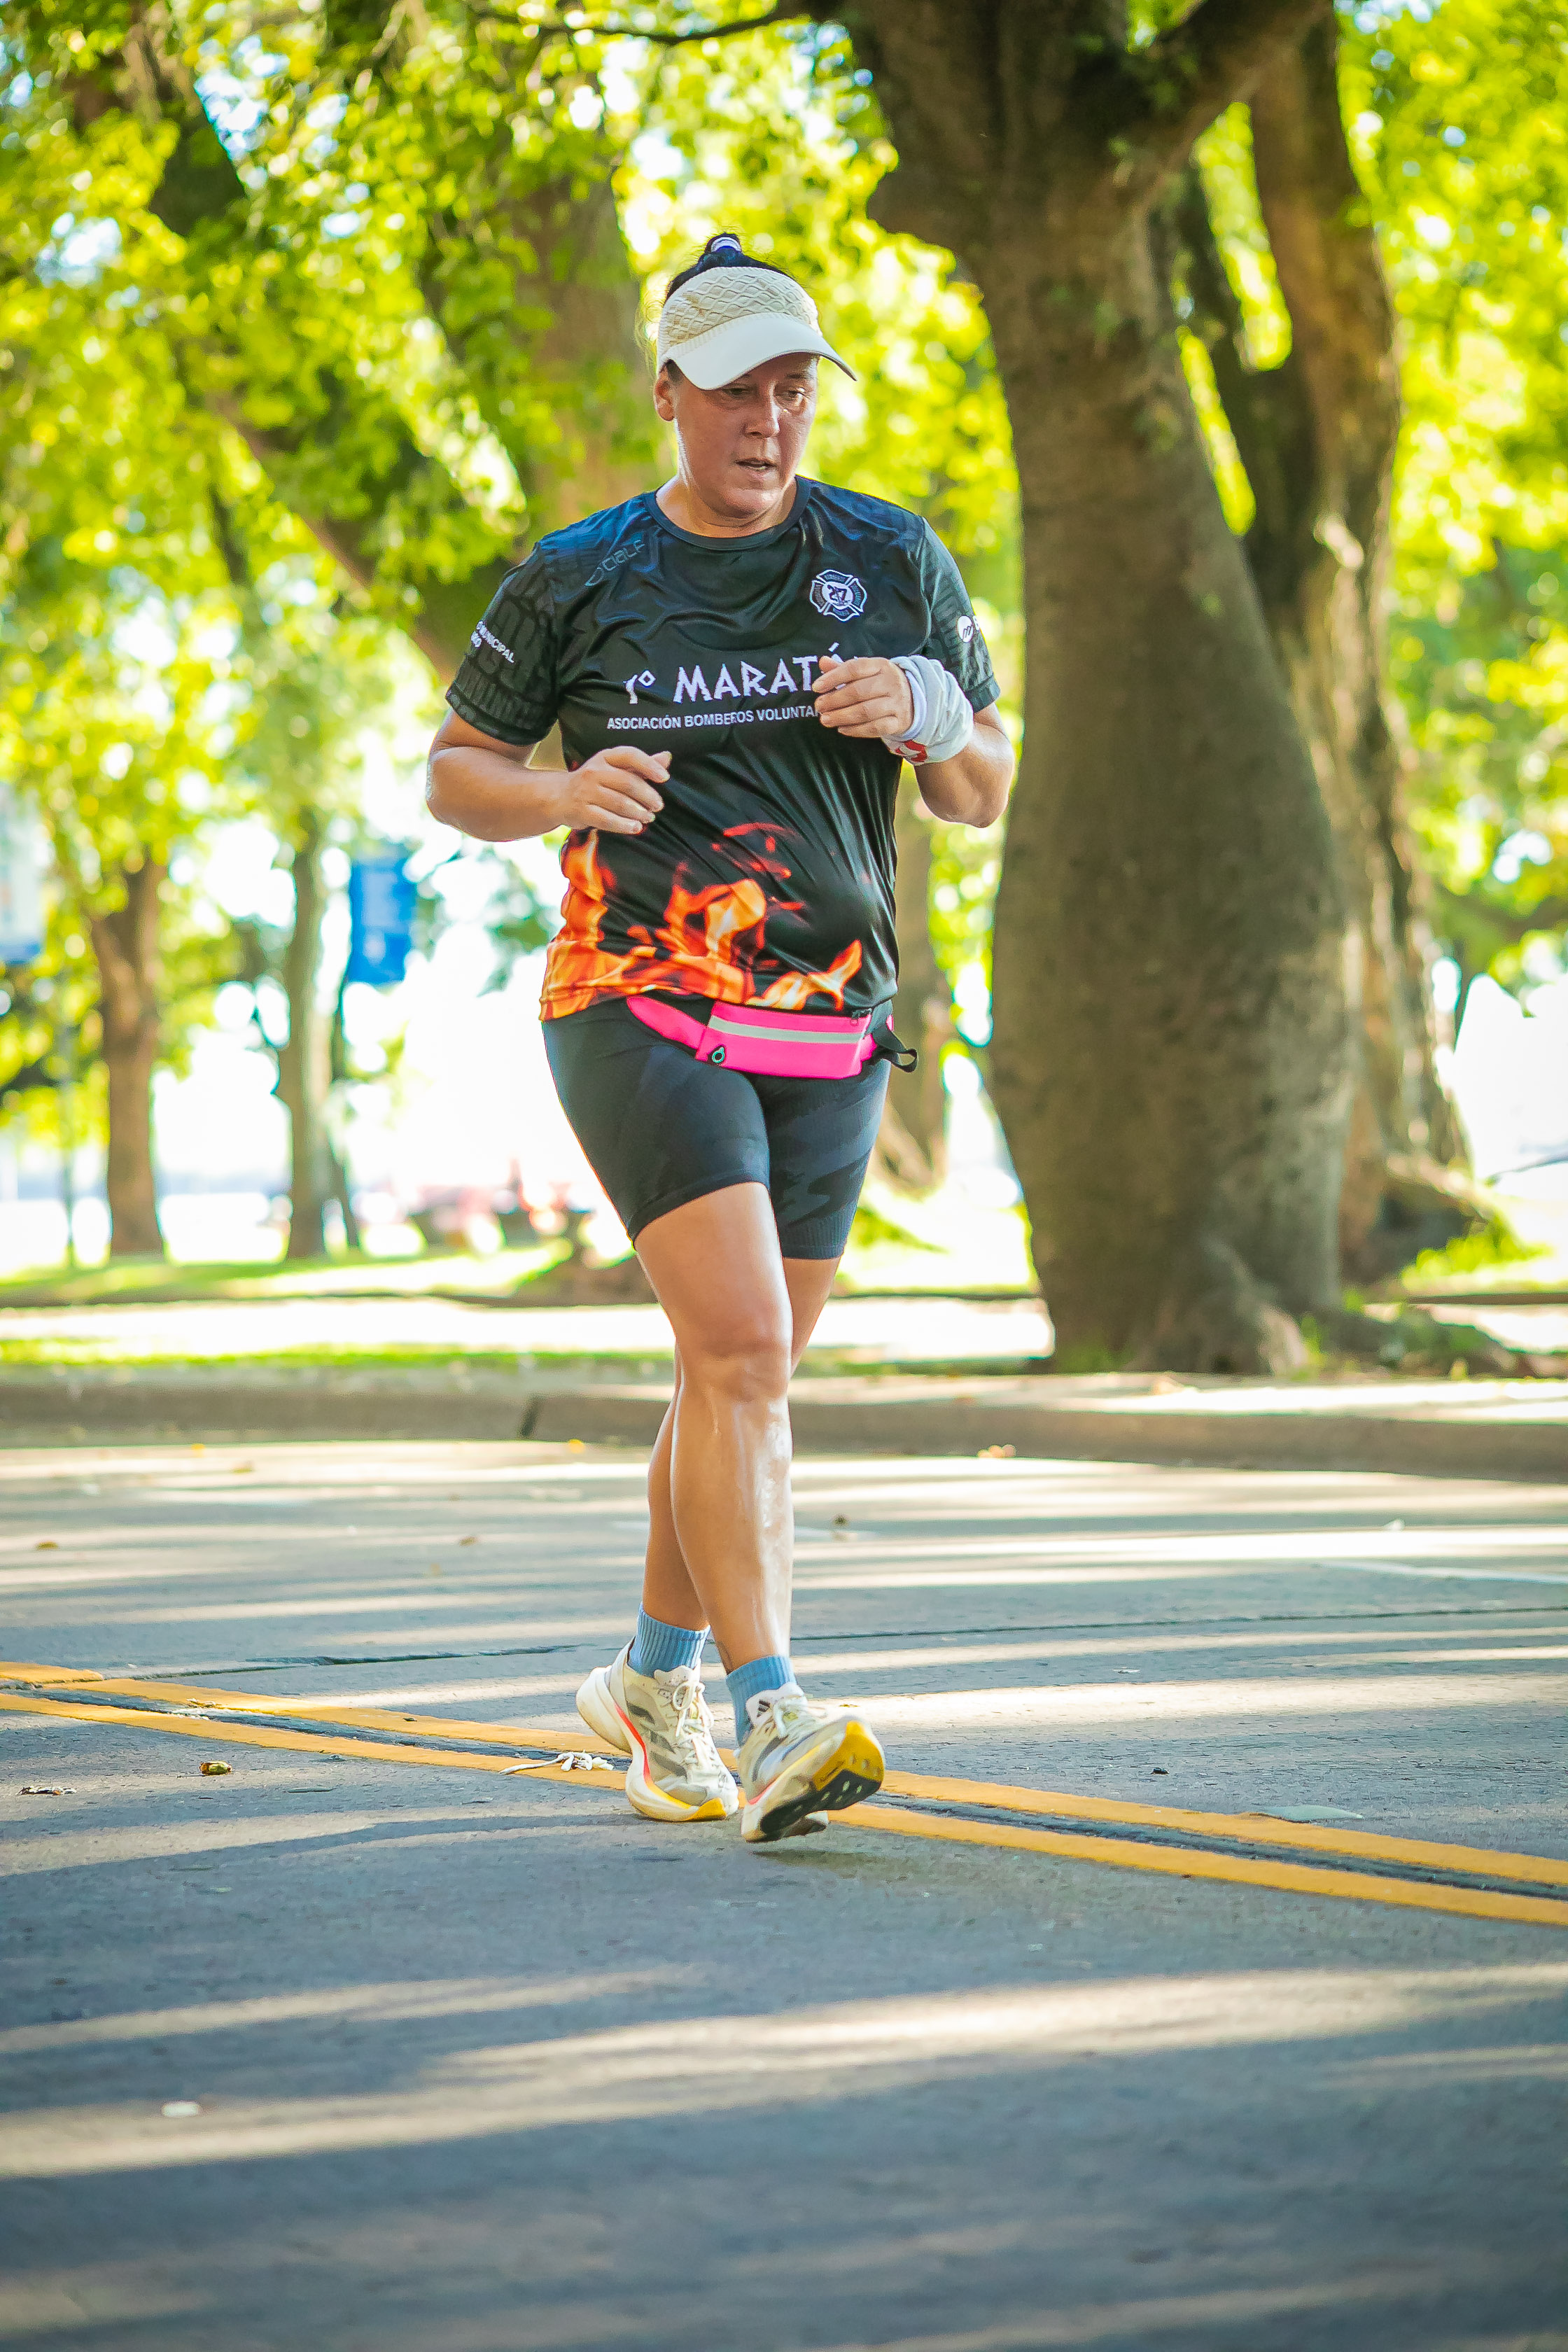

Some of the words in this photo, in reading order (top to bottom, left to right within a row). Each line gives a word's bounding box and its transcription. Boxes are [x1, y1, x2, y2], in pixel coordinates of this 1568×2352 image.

[673, 642, 857, 704] MARAT
[607, 714, 682, 730] ASOCIACIÓN
[684, 710, 755, 728] BOMBEROS
